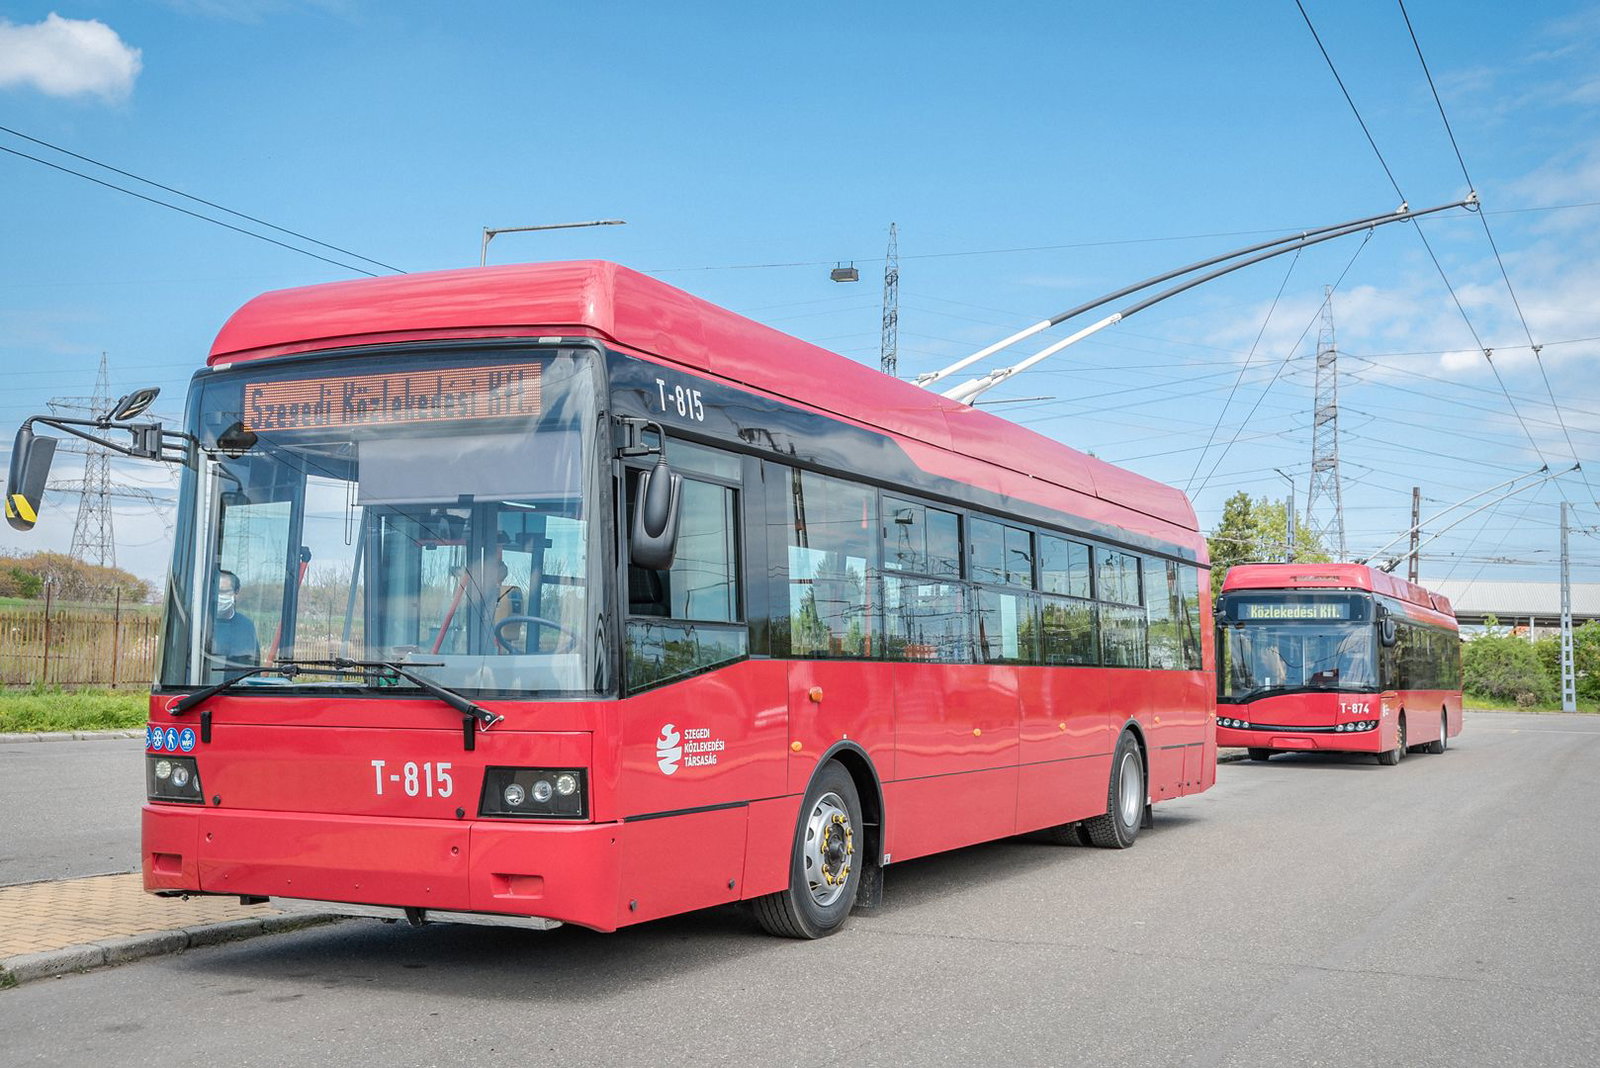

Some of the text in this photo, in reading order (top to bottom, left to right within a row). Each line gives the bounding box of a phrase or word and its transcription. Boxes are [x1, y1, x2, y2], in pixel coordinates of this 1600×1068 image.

[251, 369, 533, 430] Szegedi Közlekedési Kft.
[656, 378, 704, 422] T-815
[1251, 604, 1340, 618] Közlekedési Kft.
[1340, 702, 1370, 714] T-874
[684, 728, 710, 740] SZEGEDI
[684, 739, 725, 753] KÖZLEKEDÉSI
[684, 752, 717, 767] TÁRSASÁG
[371, 759, 453, 798] T-815
